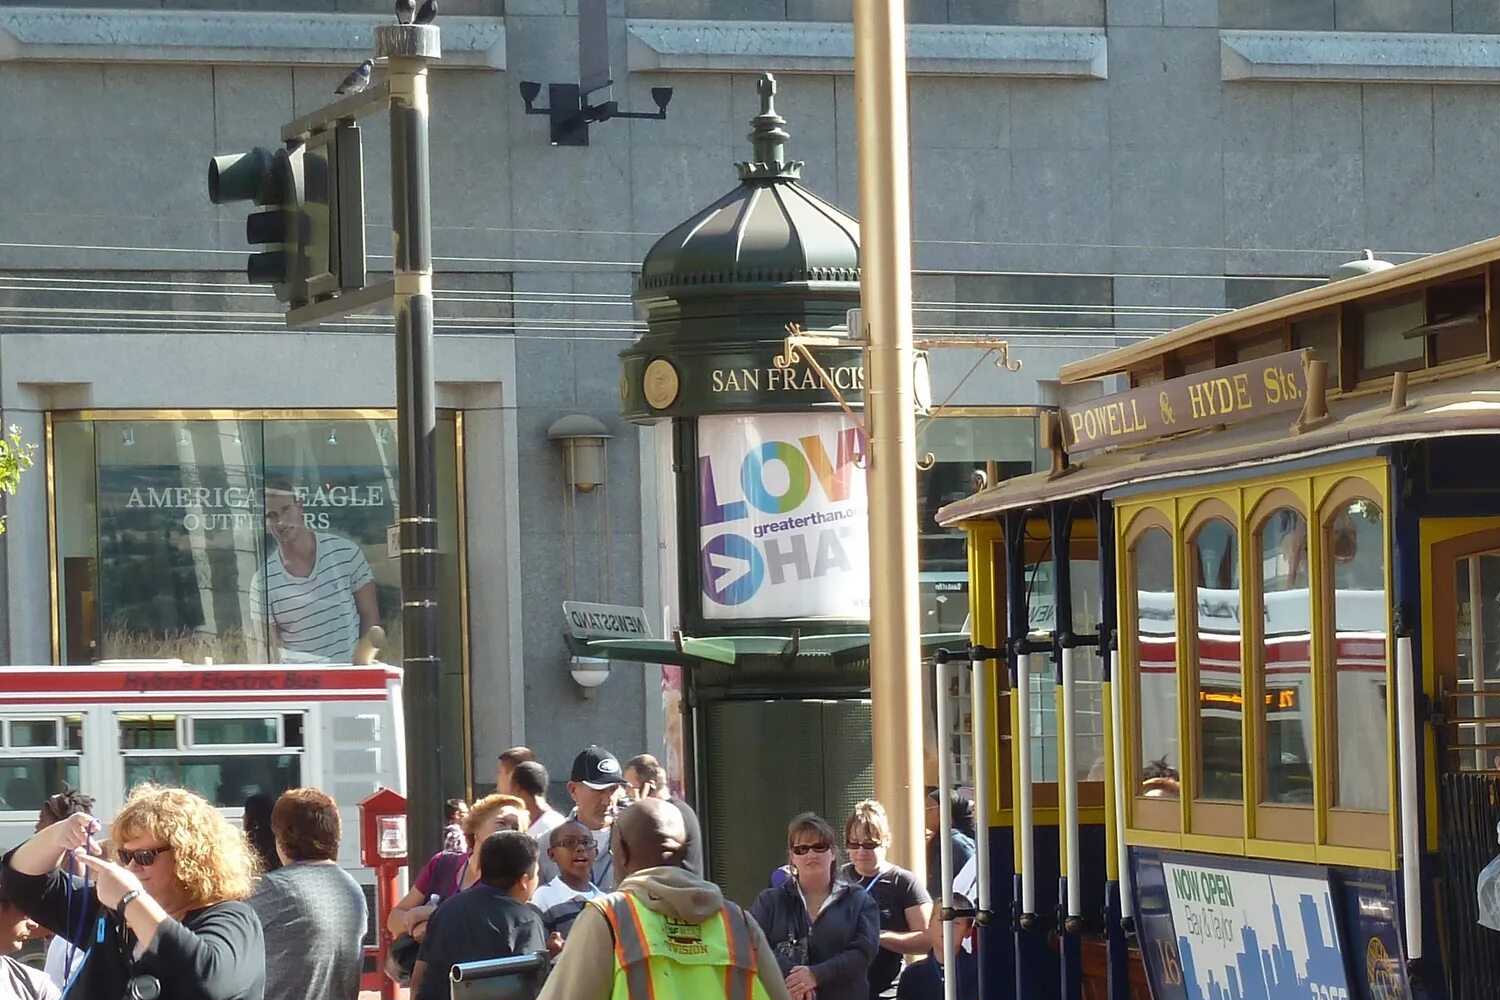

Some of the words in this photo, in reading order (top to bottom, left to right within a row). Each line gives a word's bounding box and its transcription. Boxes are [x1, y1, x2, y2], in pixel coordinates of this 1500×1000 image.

[712, 369, 760, 392] SAN
[767, 366, 865, 392] FRANCIS
[1070, 400, 1147, 445] POWELL
[1159, 391, 1176, 425] &
[1187, 373, 1253, 419] HYDE
[1263, 366, 1303, 405] Sts.
[699, 428, 868, 528] LOV
[126, 487, 262, 508] AMERICA
[294, 485, 384, 507] EAGLE
[182, 513, 330, 530] OUTFIRS
[284, 669, 320, 688] Bus
[1172, 868, 1201, 902] NOW
[1201, 871, 1235, 907] OPEN
[667, 942, 709, 956] IVISION
[1156, 938, 1181, 986] 16
